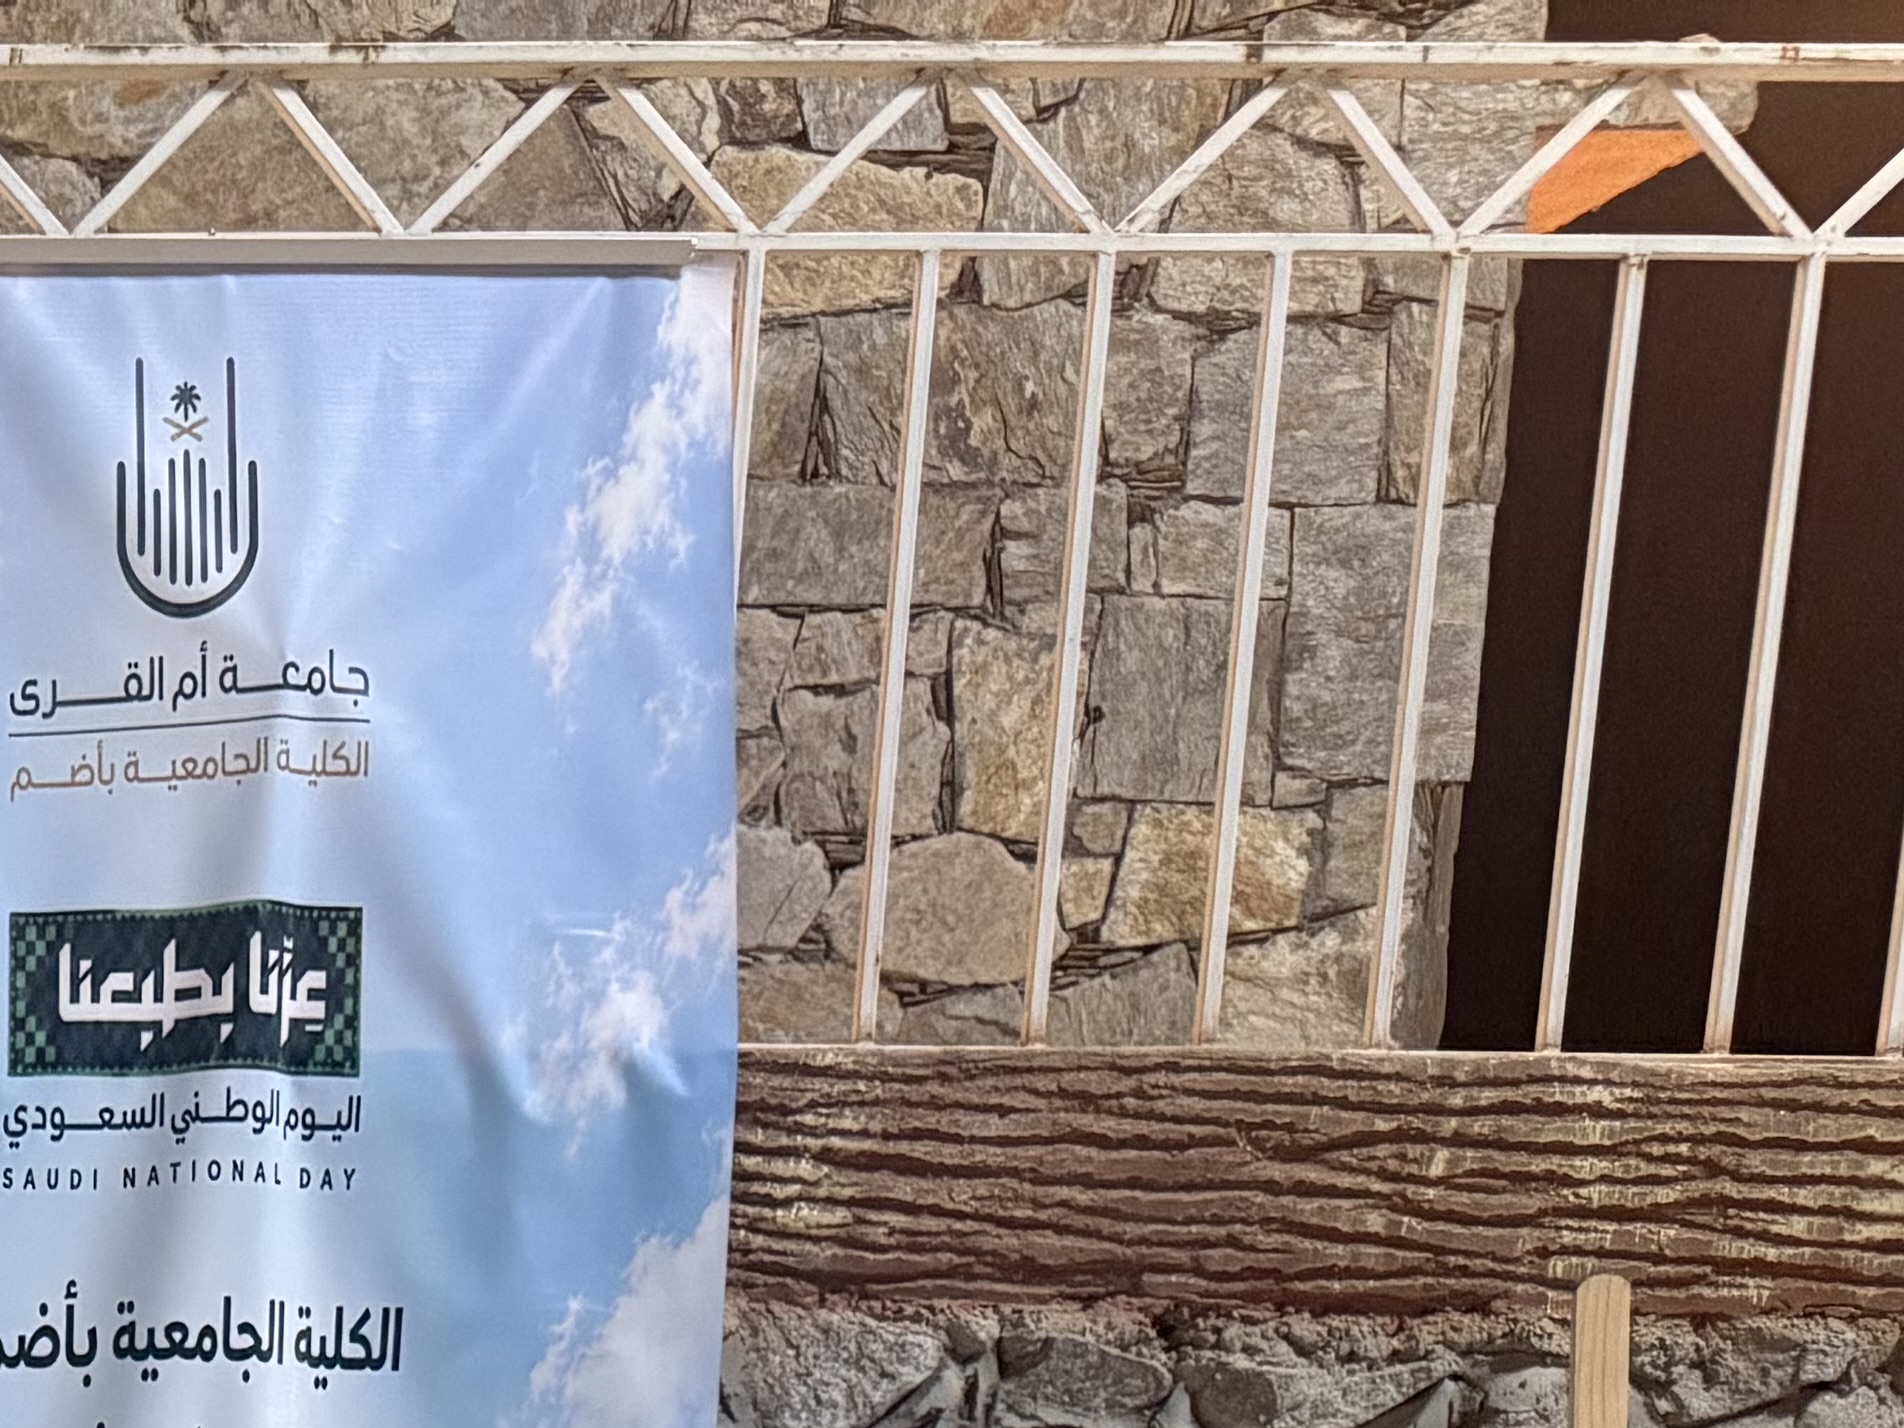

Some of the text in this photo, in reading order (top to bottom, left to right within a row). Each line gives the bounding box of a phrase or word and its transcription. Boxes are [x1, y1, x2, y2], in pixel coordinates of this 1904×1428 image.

[9, 641, 370, 719] جامعة أم القرى
[10, 736, 370, 802] الكلية الجامعية بأضم
[58, 938, 234, 1052] بطبعنا
[3, 1086, 361, 1150] اليوم الوطني السعودي
[2, 1159, 356, 1191] SAUDI NATIONAL DAY
[112, 1296, 285, 1383] الجامعية
[293, 1305, 404, 1390] الكلية
